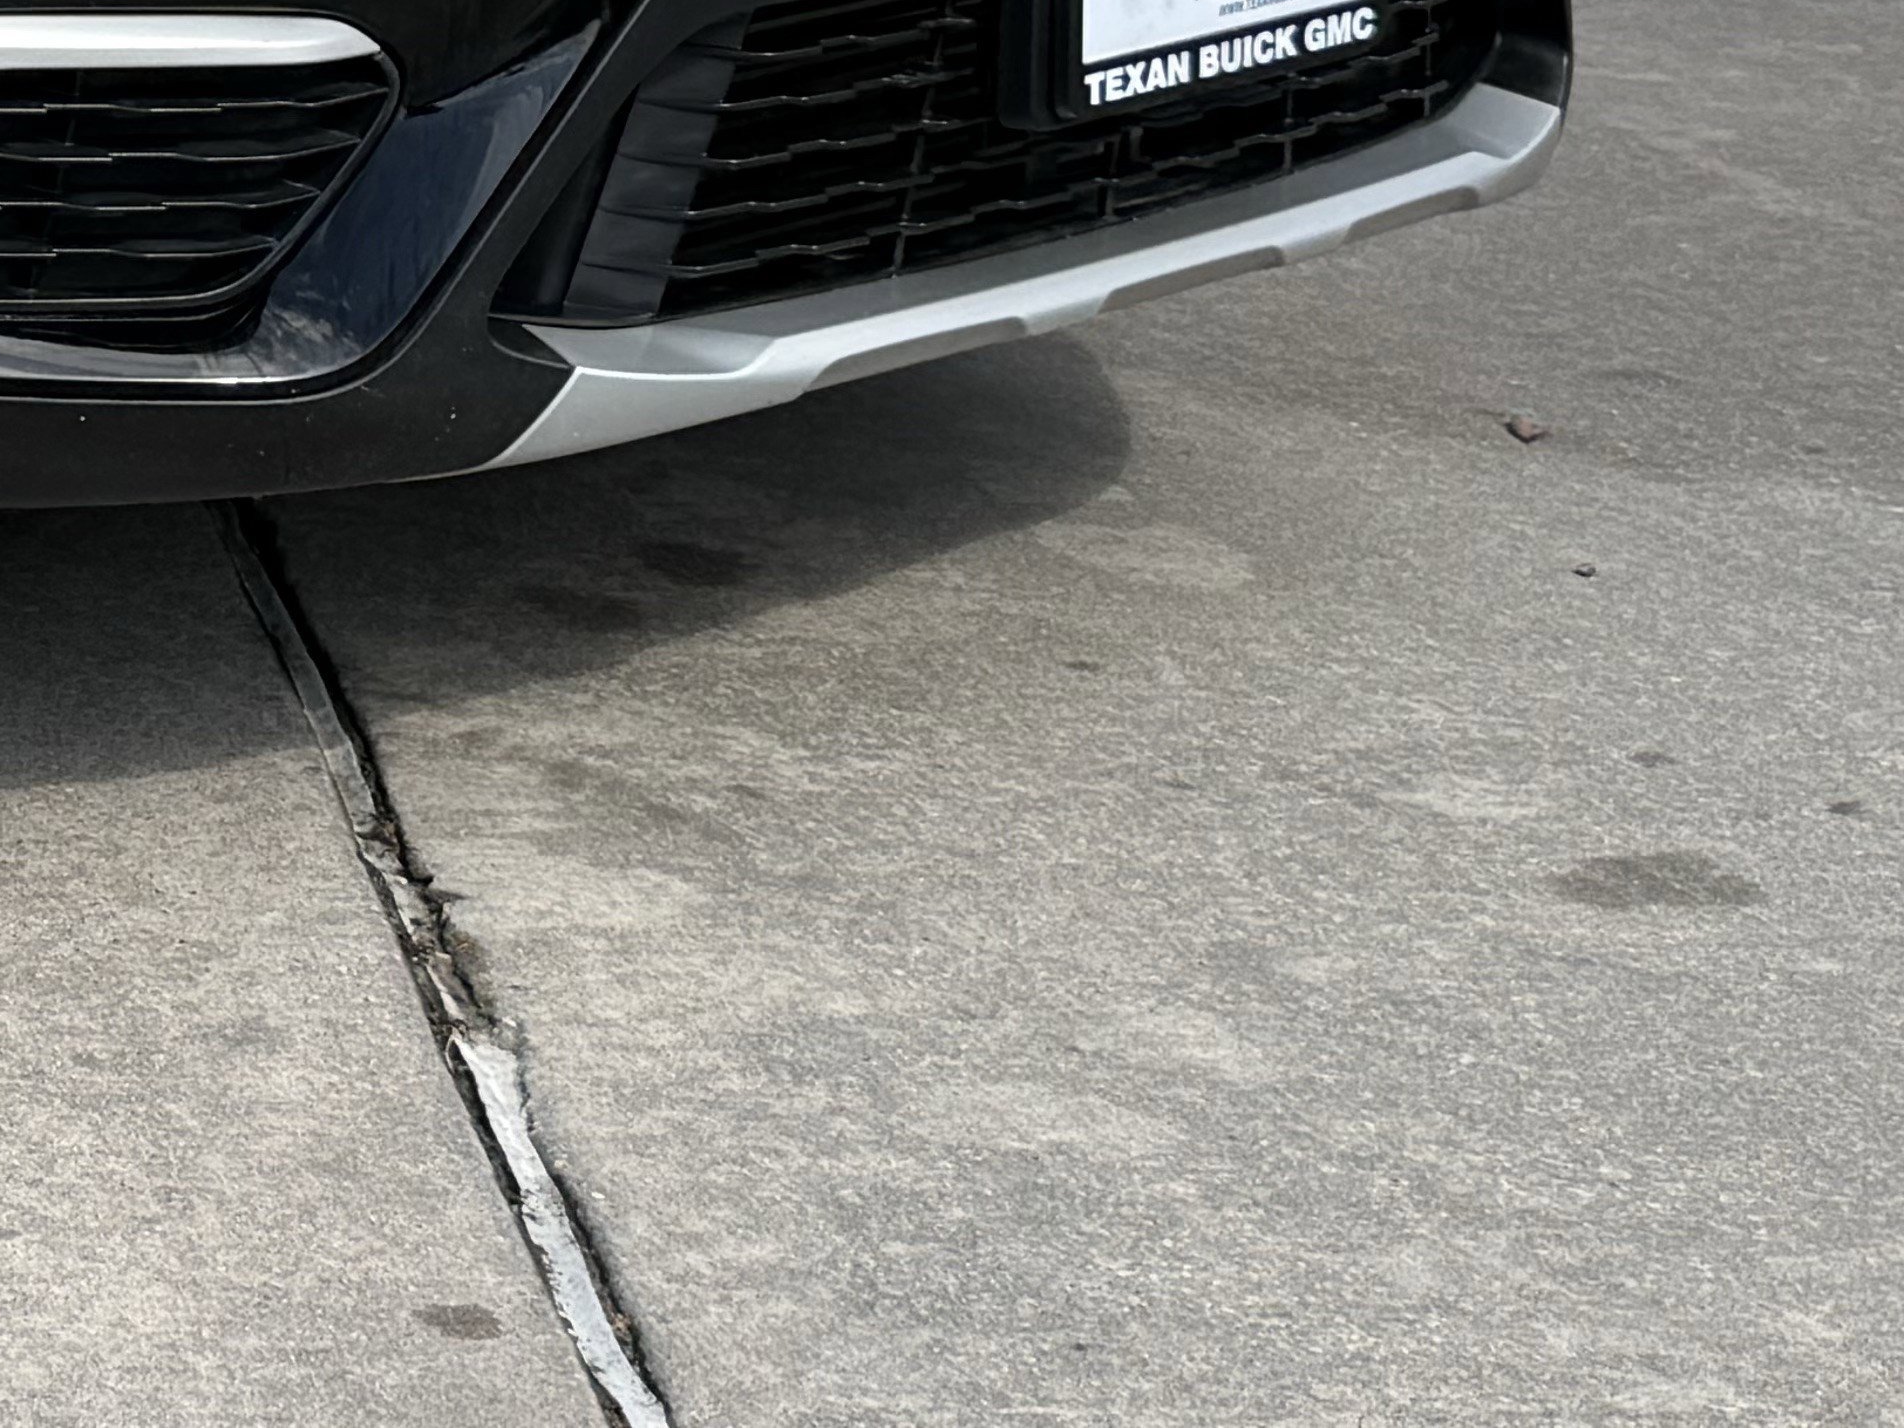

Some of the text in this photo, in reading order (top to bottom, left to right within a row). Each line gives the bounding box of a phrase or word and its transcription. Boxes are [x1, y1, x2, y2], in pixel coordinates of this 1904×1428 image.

[1084, 6, 1379, 106] TEXAN BUICK GMC
